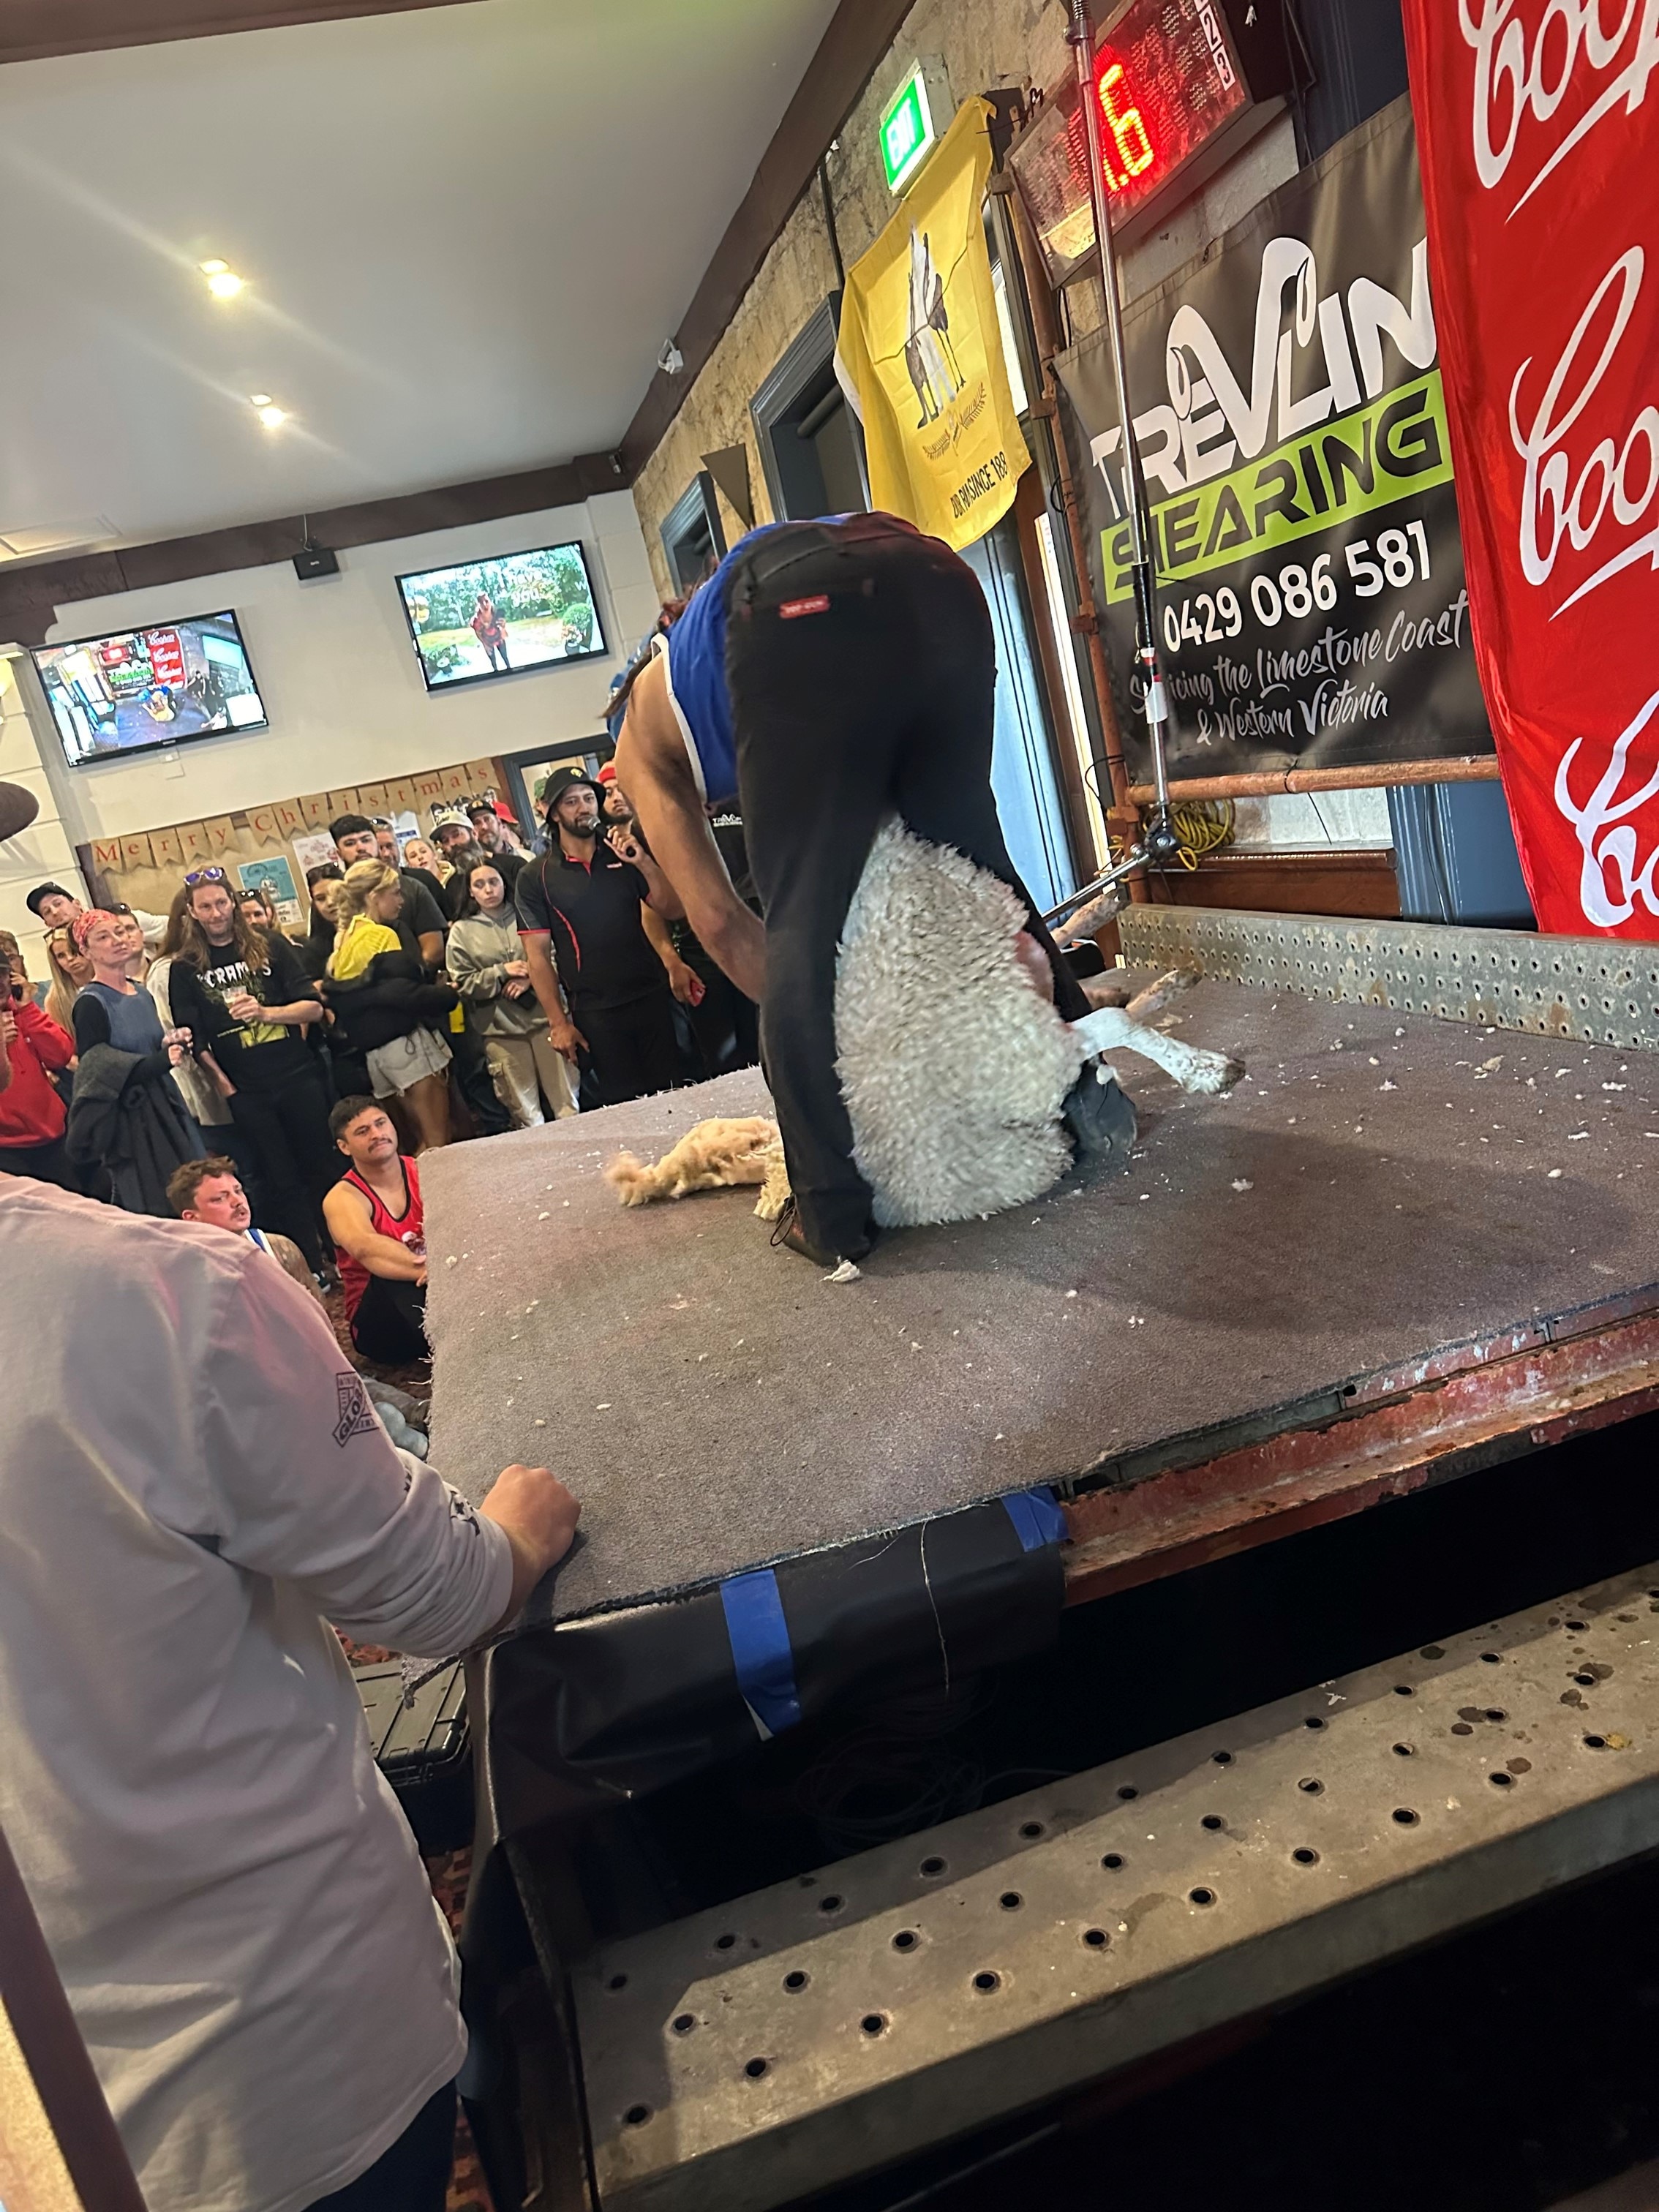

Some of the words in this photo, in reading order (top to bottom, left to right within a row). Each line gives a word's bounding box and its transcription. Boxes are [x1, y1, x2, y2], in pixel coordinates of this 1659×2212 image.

[886, 97, 916, 172] EXIT
[1089, 237, 1437, 519] TREVLIN
[967, 464, 996, 501] SINCE
[1163, 587, 1243, 653] 0429
[1250, 553, 1338, 628] 086
[1344, 519, 1431, 598] 581
[1129, 670, 1214, 715] Sicing
[1213, 654, 1252, 698] the
[1257, 626, 1383, 699] Limestone
[1385, 589, 1470, 663] Coast
[1196, 708, 1213, 746] &
[1214, 696, 1295, 742] Western
[1297, 678, 1388, 737] Victoria
[95, 827, 227, 864] Merry
[255, 767, 488, 832] Christmas
[205, 958, 272, 988] CRAMS
